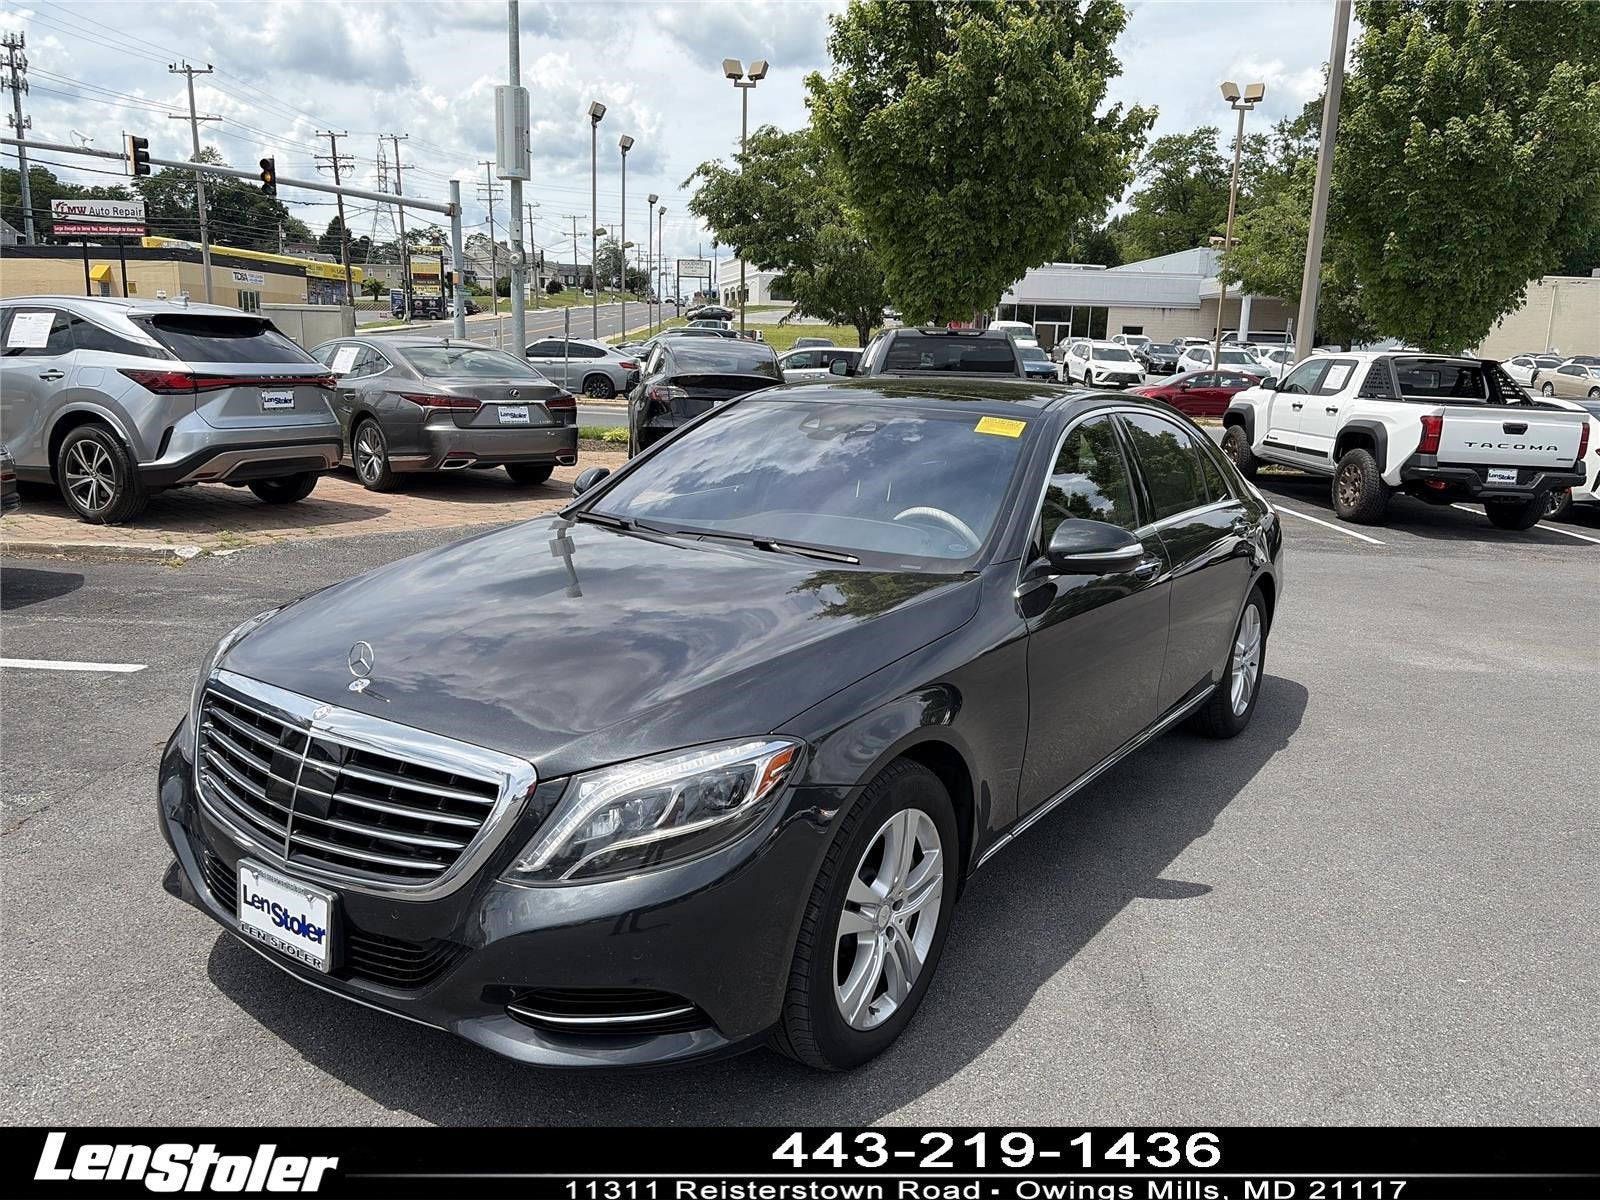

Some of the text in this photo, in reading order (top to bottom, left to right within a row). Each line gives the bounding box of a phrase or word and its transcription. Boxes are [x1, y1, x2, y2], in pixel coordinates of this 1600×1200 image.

[89, 206, 110, 216] Auto
[112, 206, 143, 217] Repair
[1464, 441, 1558, 451] TACOMA
[243, 884, 326, 945] LenStoler
[241, 923, 322, 970] LEN STOLER
